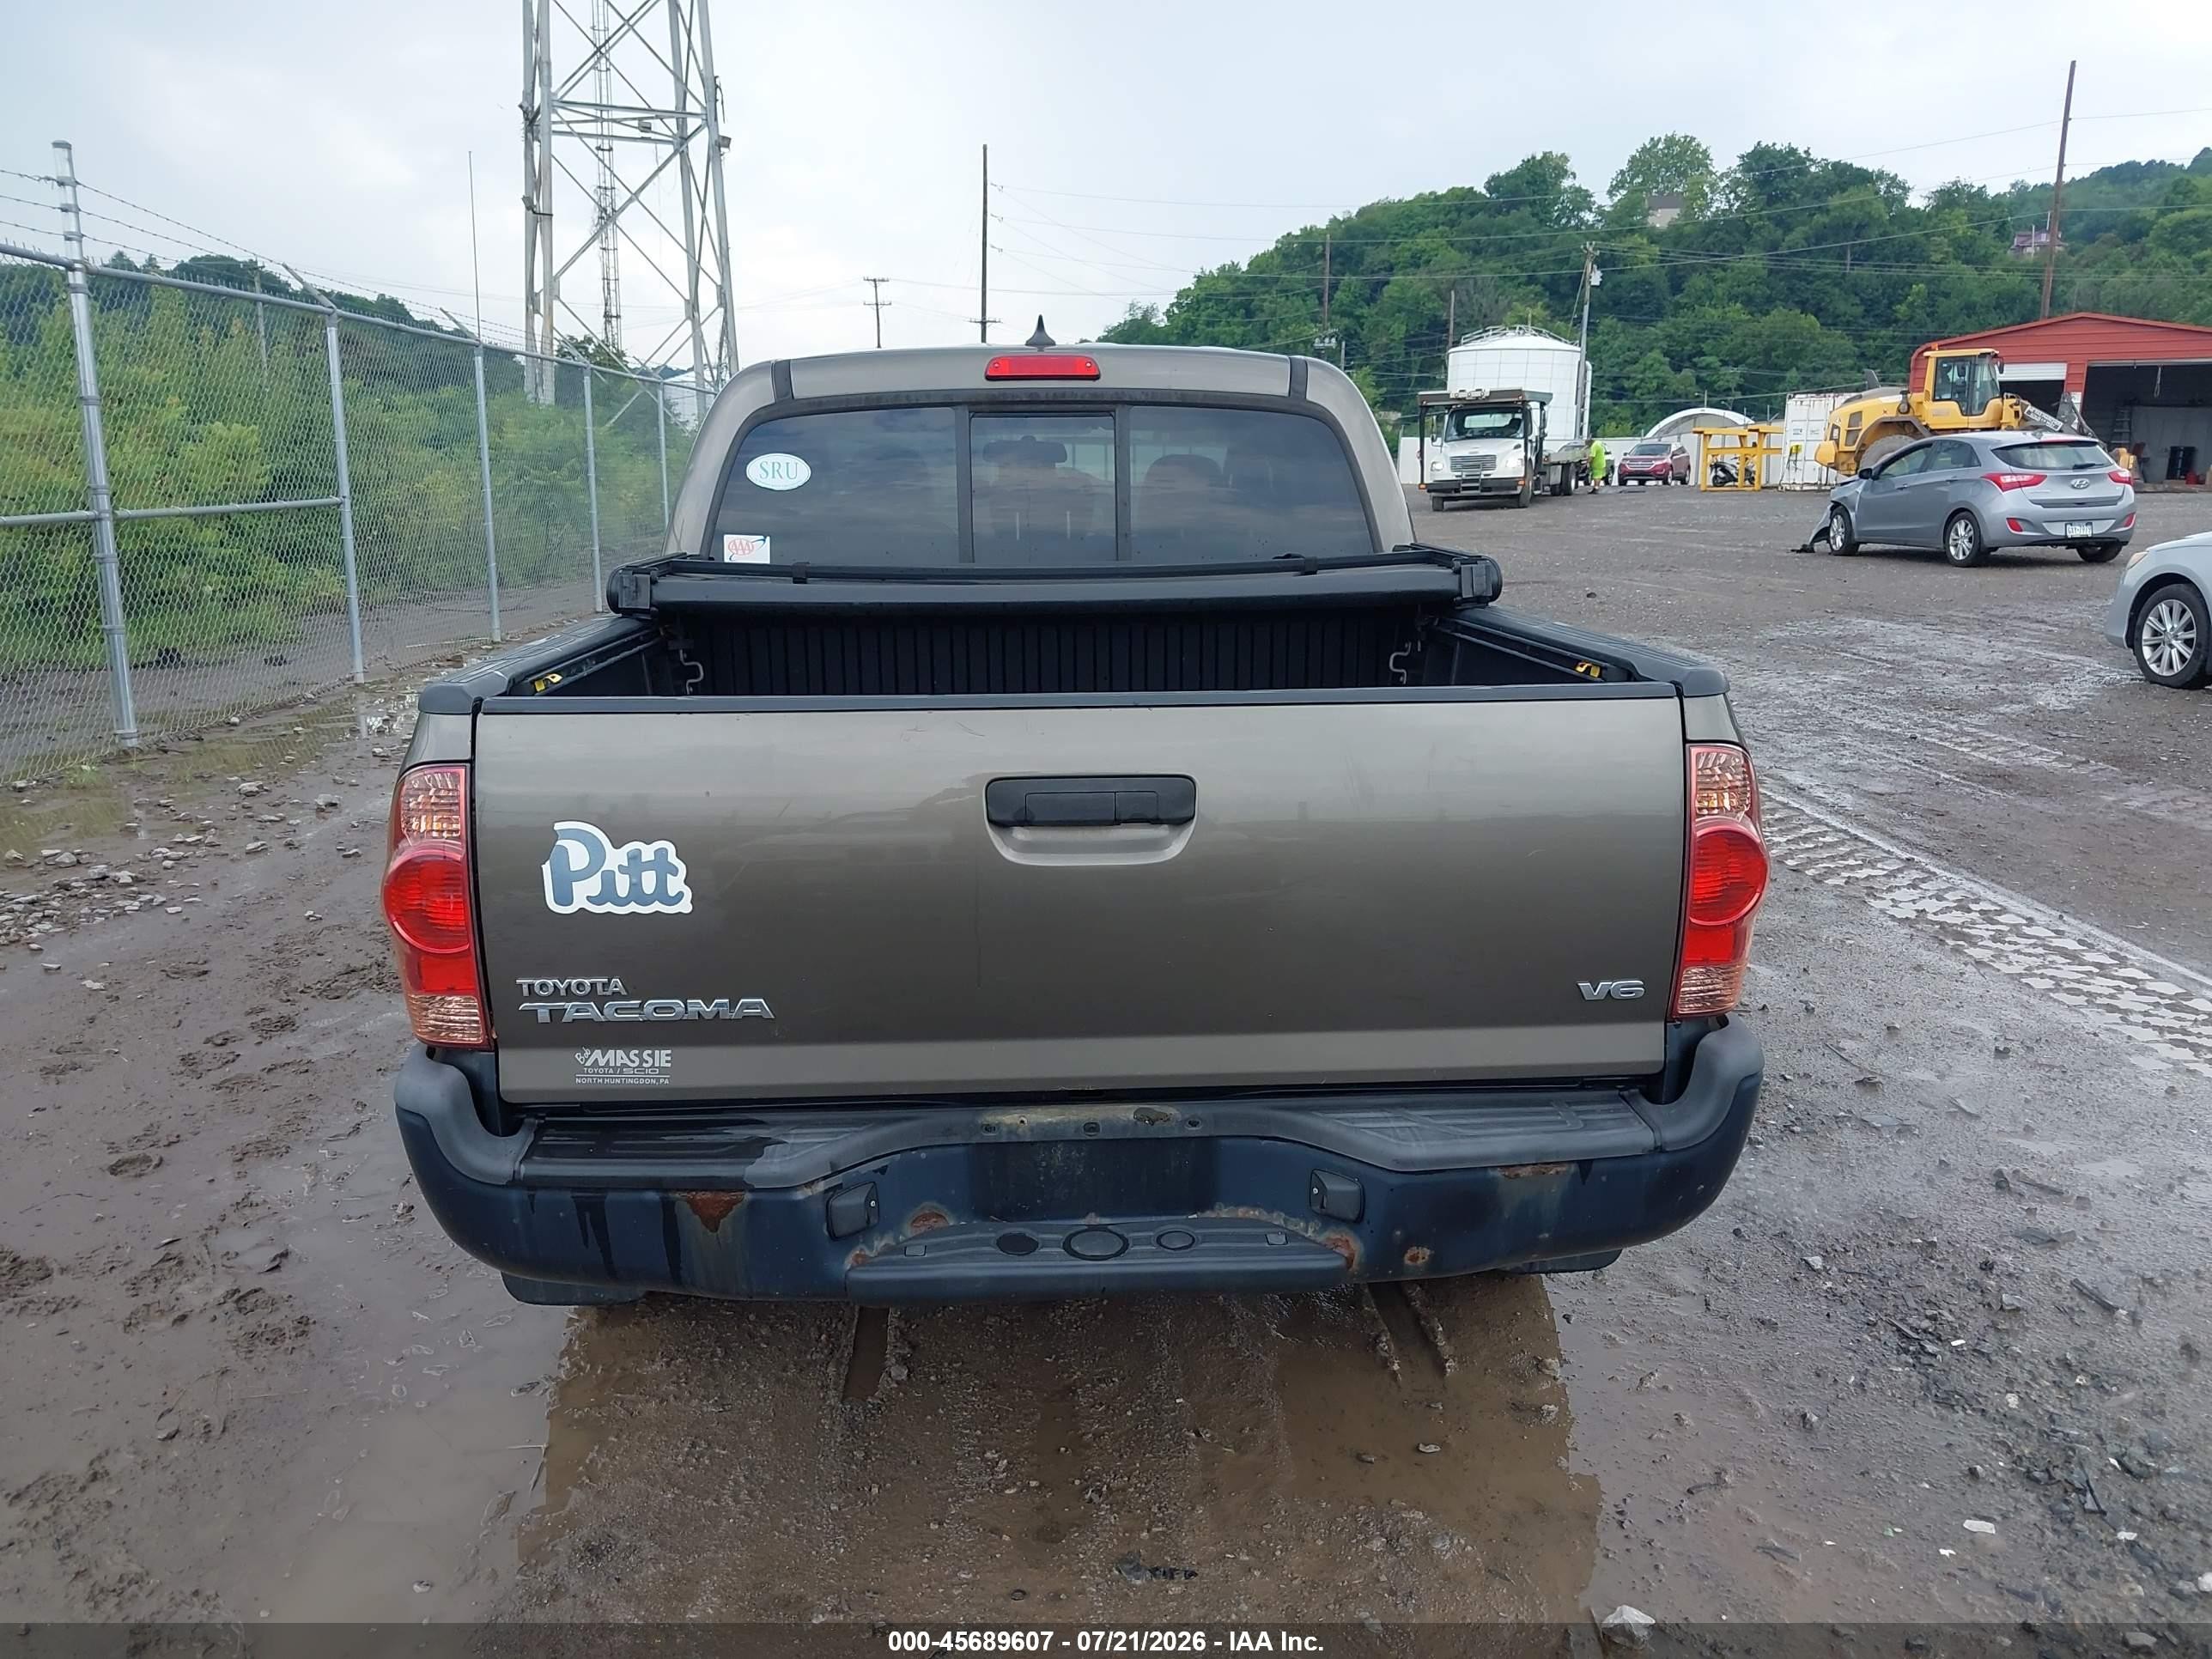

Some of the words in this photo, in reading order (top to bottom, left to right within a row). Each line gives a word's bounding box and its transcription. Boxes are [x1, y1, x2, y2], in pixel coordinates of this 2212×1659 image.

[758, 460, 799, 480] SRU
[547, 827, 684, 907] Pitt
[515, 977, 628, 997] TOYOTA
[1577, 980, 1645, 1000] V6
[519, 998, 775, 1024] TACOMA
[574, 1047, 591, 1065] Bob
[584, 1049, 672, 1067] MASSIE
